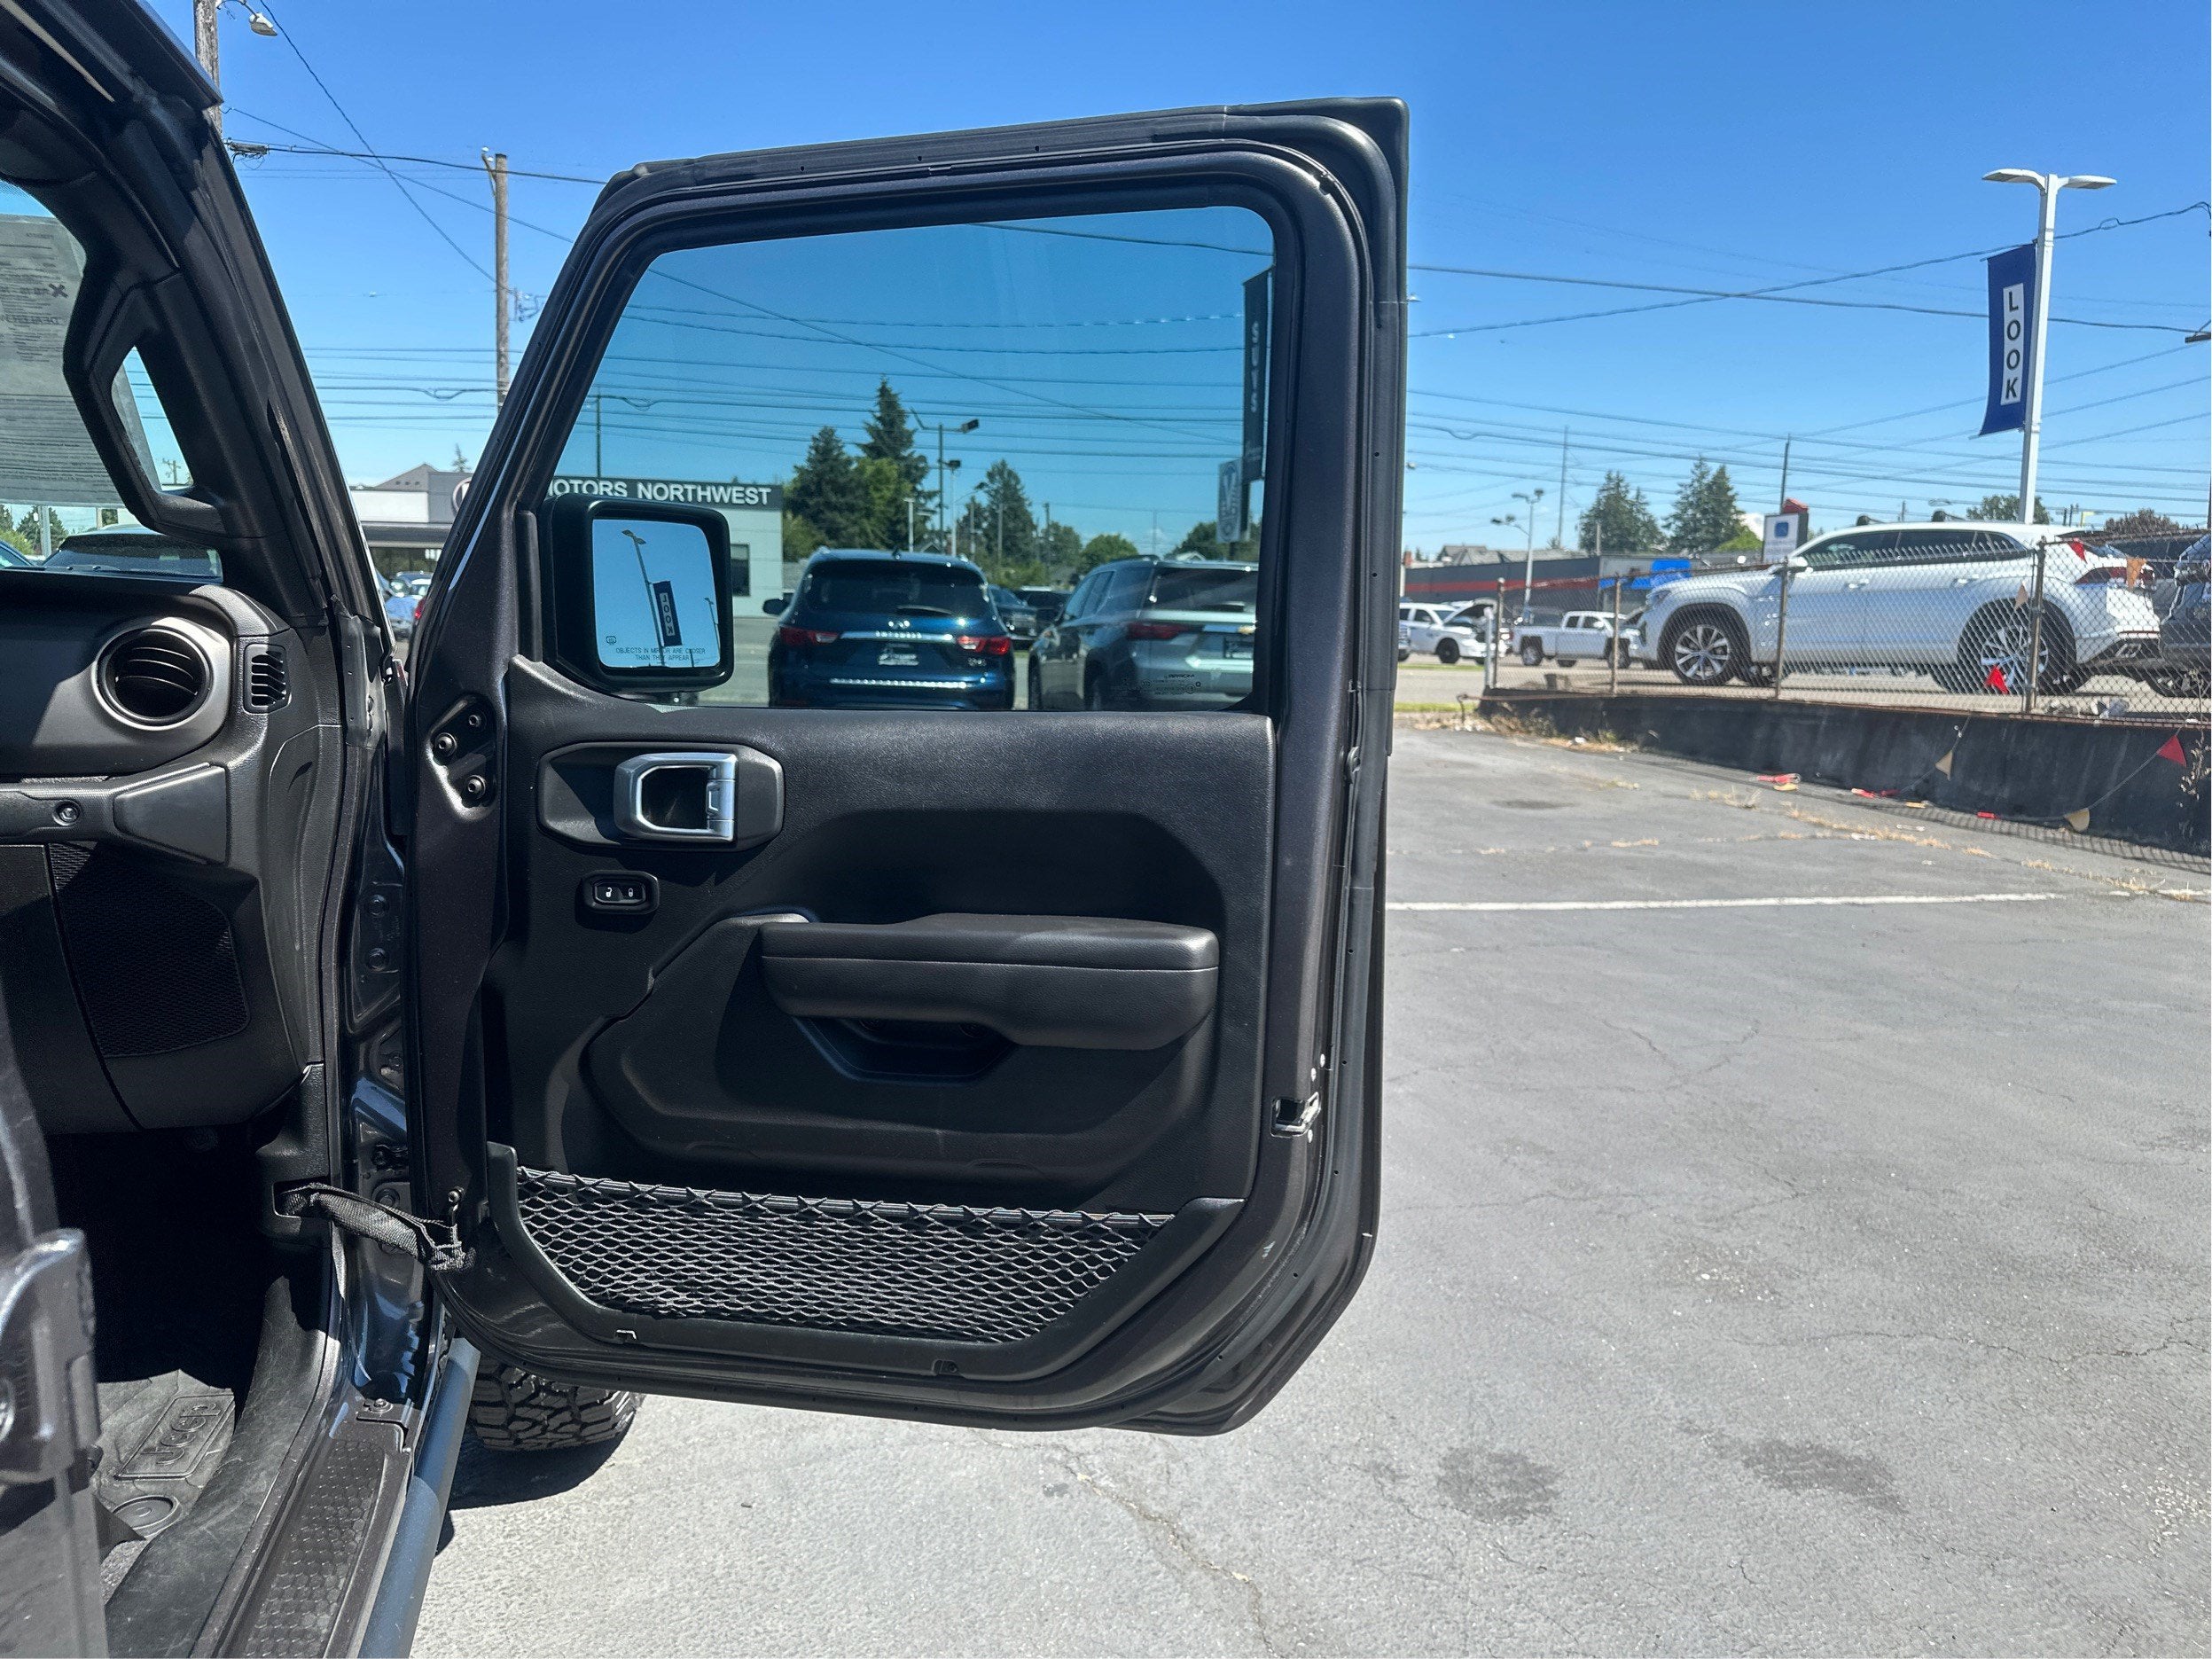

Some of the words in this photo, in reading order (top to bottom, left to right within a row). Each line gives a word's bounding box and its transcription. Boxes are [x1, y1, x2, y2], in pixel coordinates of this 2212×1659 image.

[2005, 291, 2021, 399] LOOK
[637, 482, 772, 505] NORTHWEST
[139, 1403, 223, 1466] Jeep
